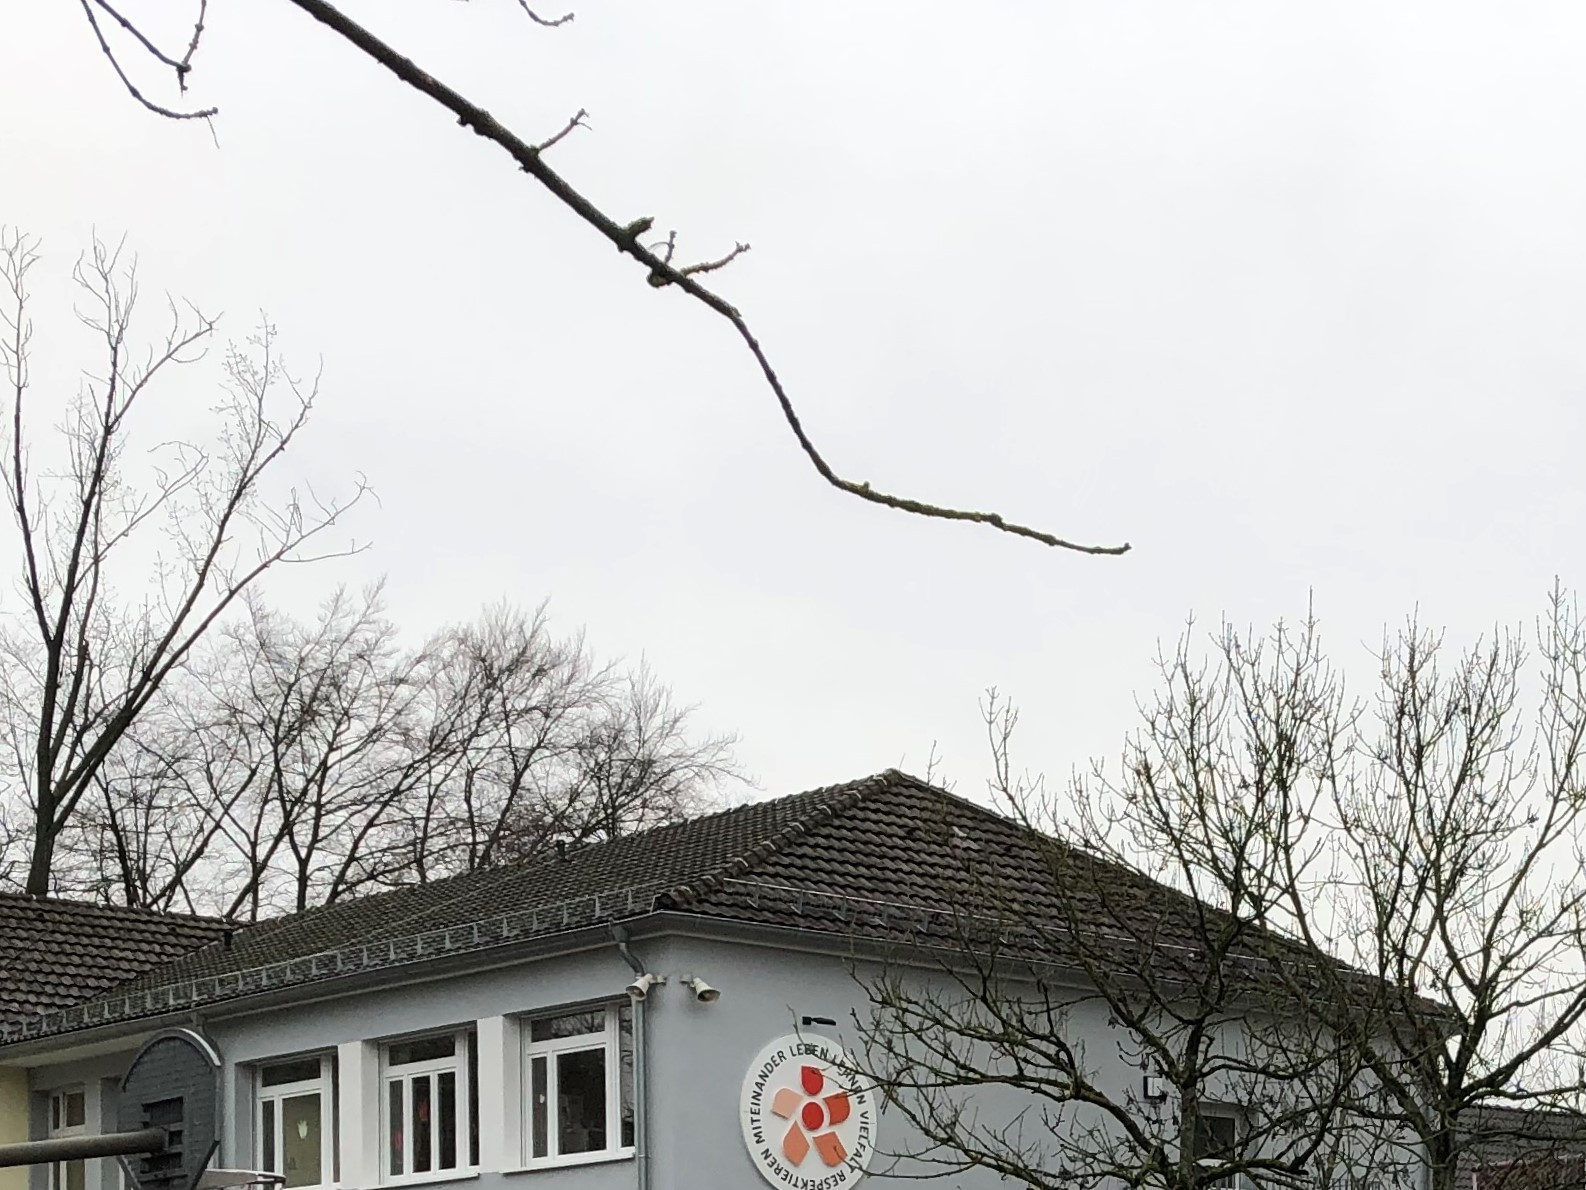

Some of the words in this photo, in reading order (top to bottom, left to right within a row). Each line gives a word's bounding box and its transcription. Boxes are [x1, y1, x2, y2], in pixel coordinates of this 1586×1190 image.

[789, 1043, 829, 1060] LEBEN
[750, 1050, 788, 1145] MITEINANDER
[849, 1110, 869, 1174] VIELFALT
[761, 1148, 847, 1190] RESPEKTIEREN
